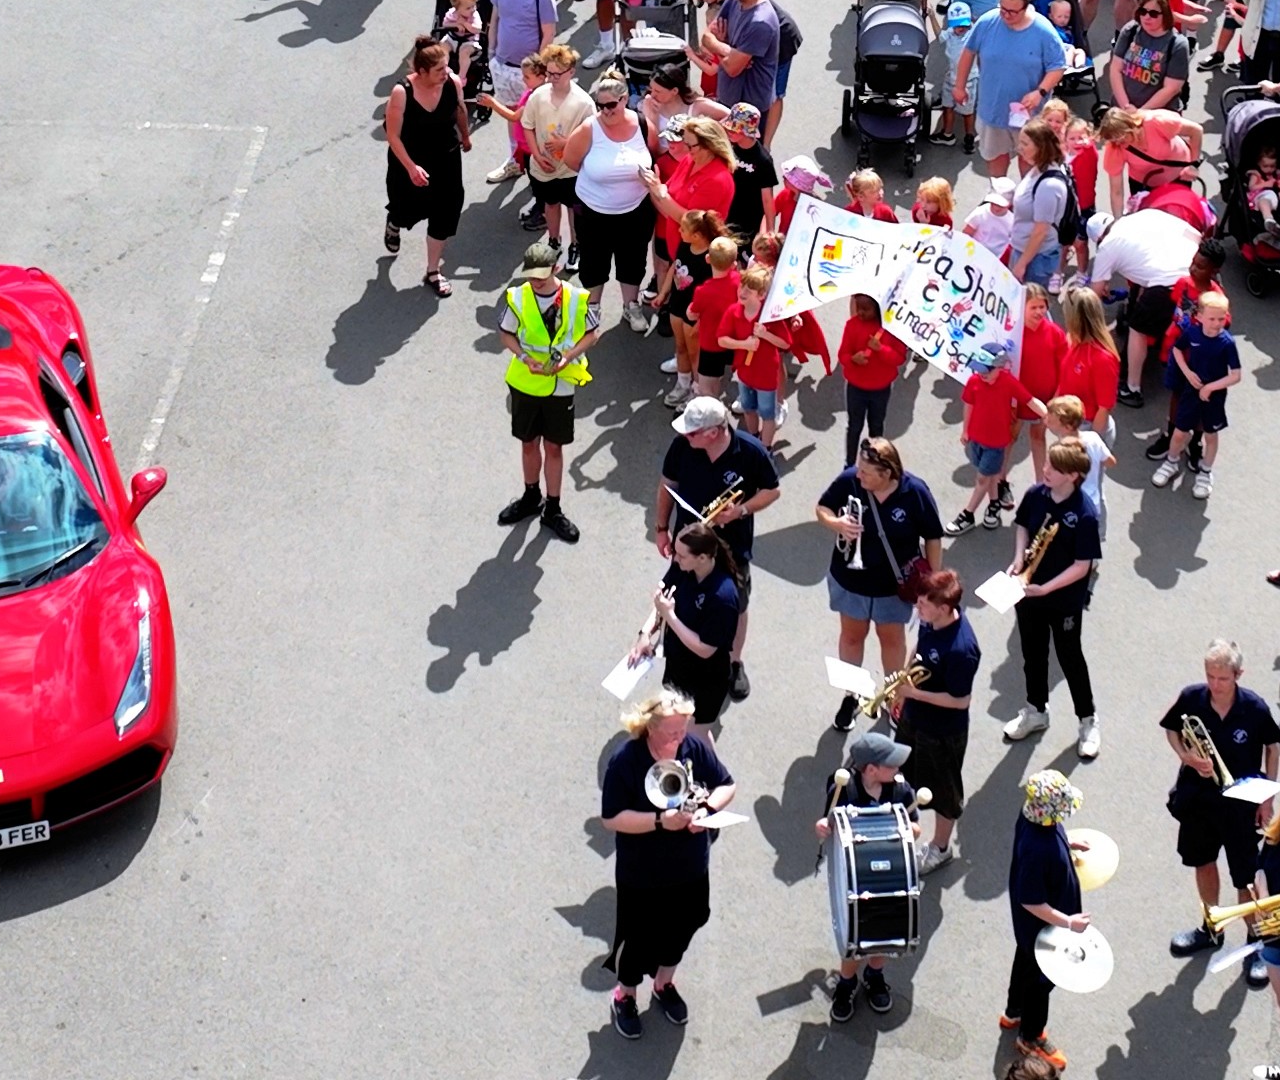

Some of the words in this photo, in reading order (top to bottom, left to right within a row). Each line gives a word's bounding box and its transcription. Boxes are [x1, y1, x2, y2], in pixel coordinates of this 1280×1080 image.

[887, 300, 945, 357] rimary
[922, 284, 939, 302] C
[963, 314, 983, 338] E
[8, 824, 46, 845] FER
